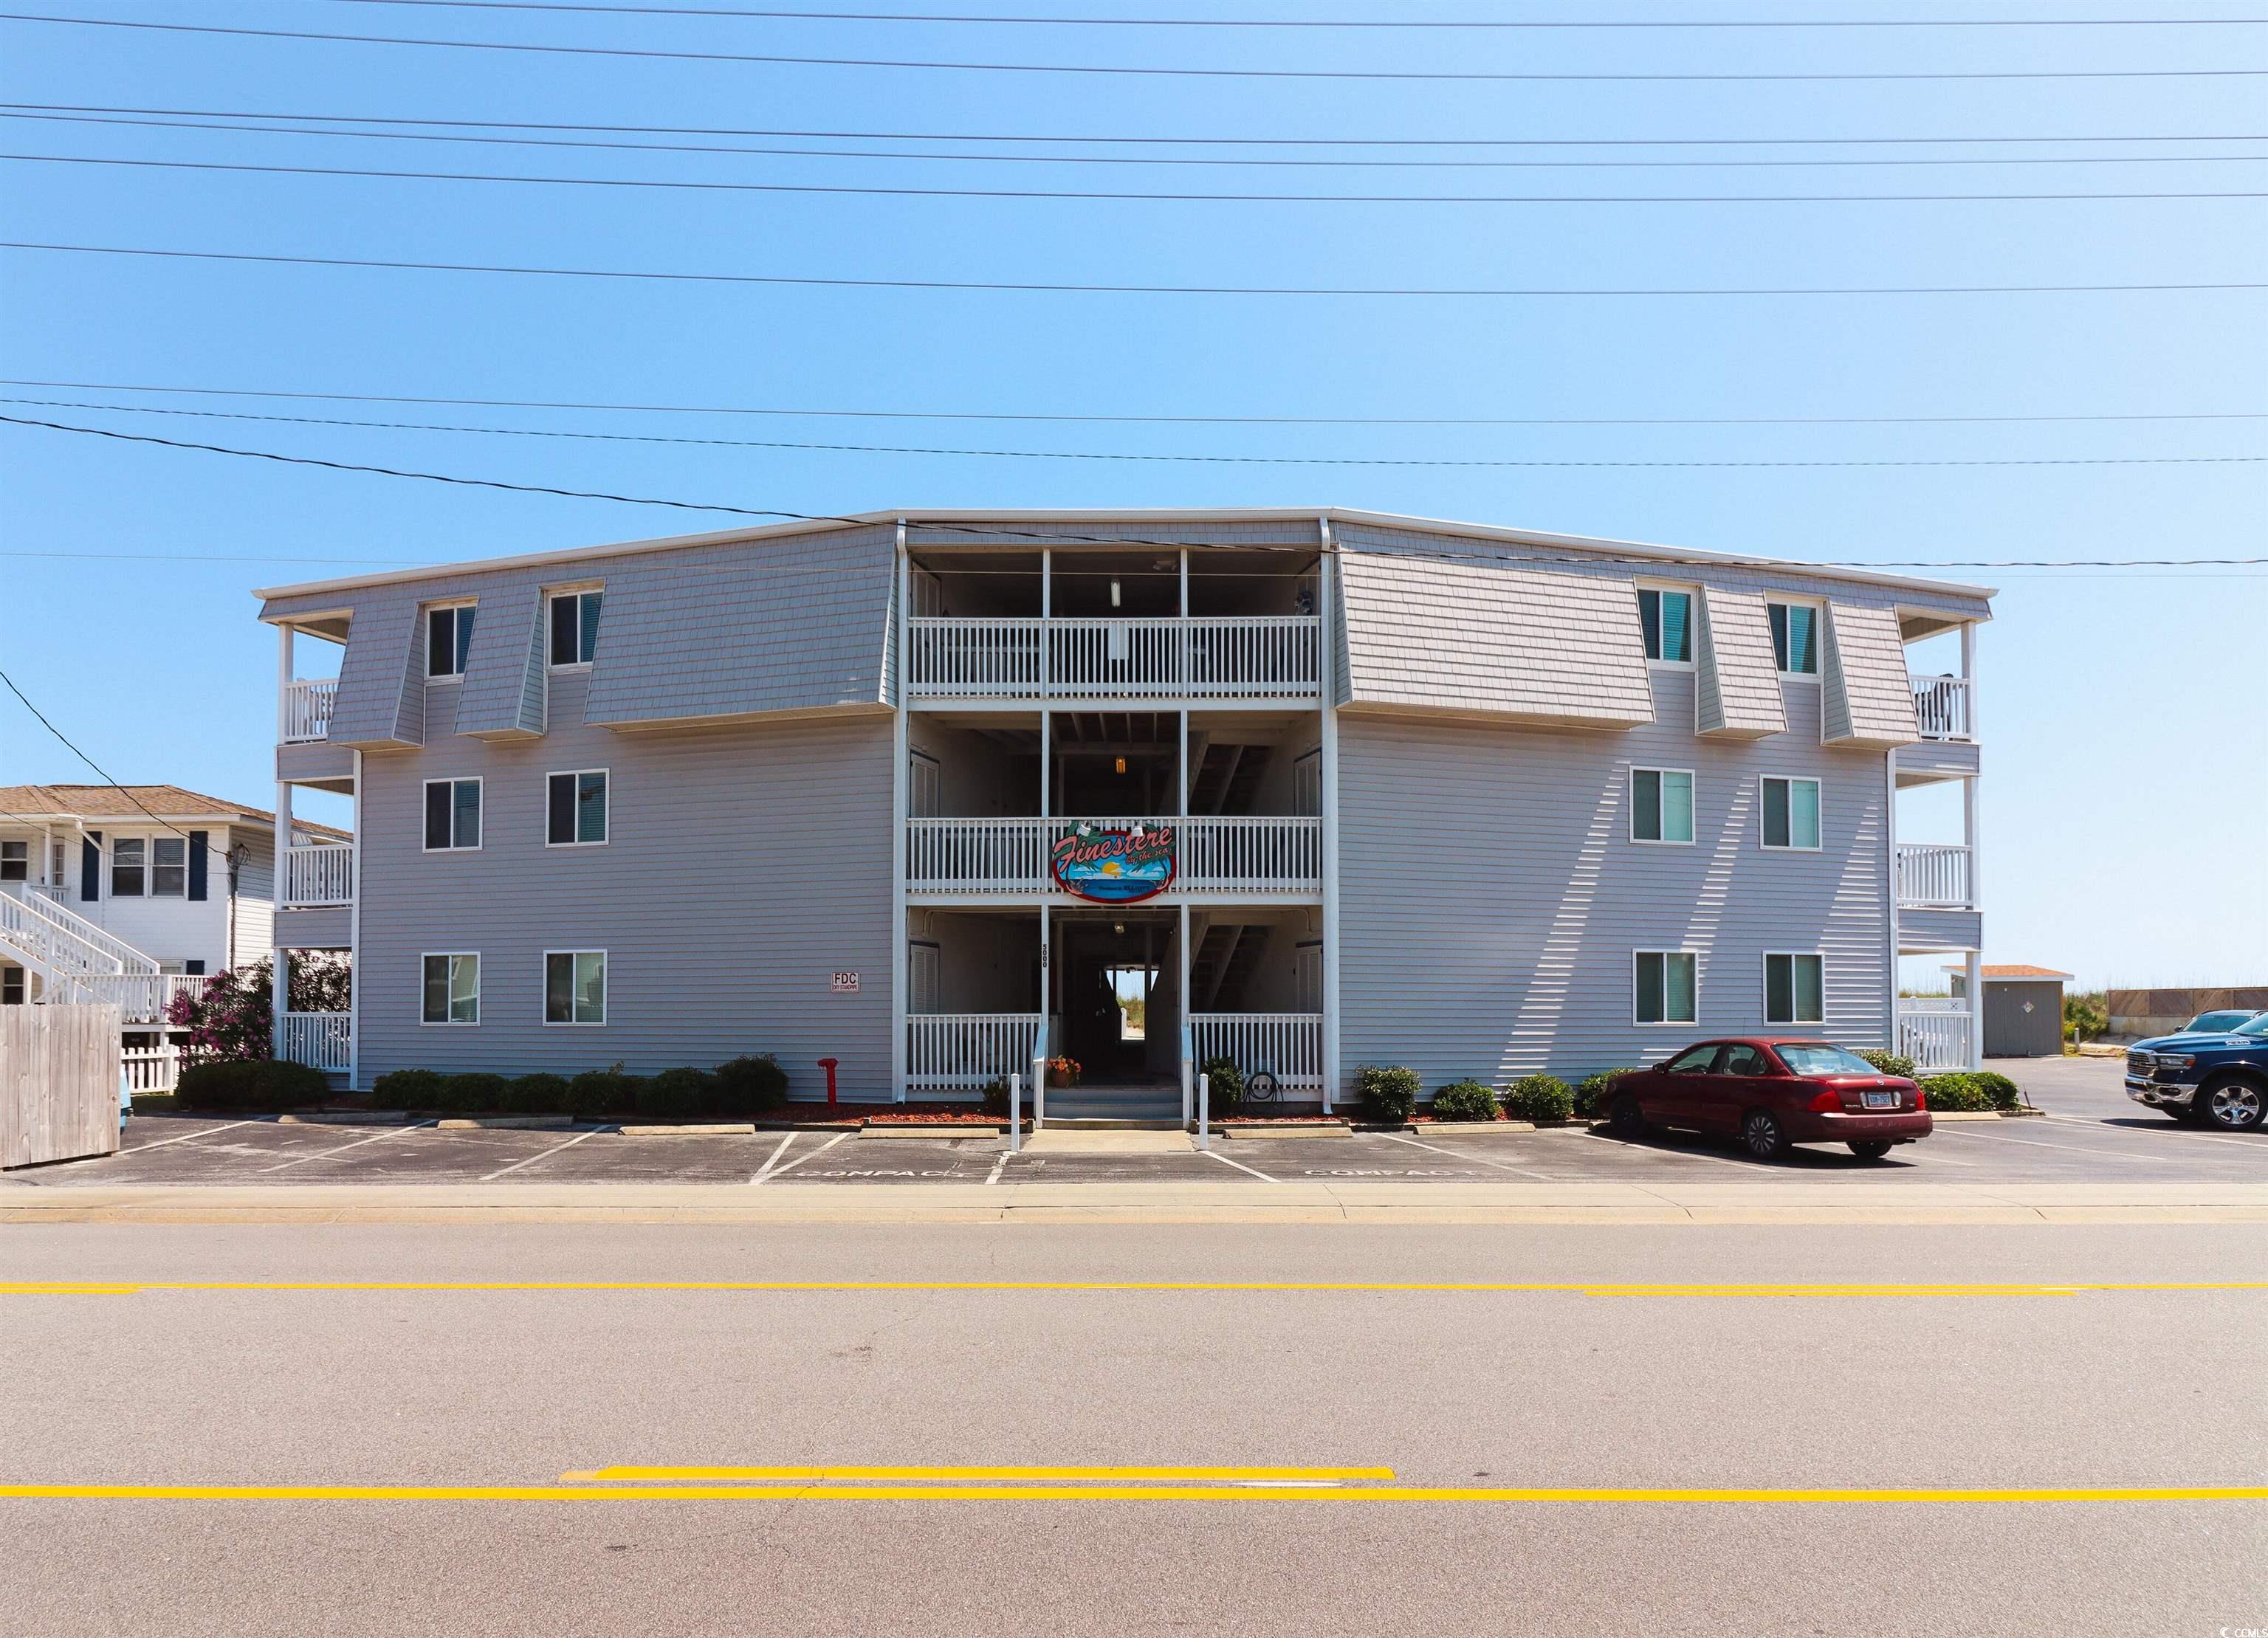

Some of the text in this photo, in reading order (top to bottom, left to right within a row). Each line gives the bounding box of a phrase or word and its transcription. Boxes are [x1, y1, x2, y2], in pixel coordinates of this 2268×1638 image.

[1053, 827, 1172, 873] Finestere
[1126, 855, 1138, 864] by
[1138, 850, 1152, 861] the
[834, 973, 856, 984] FDC
[797, 1169, 973, 1177] COMPACT
